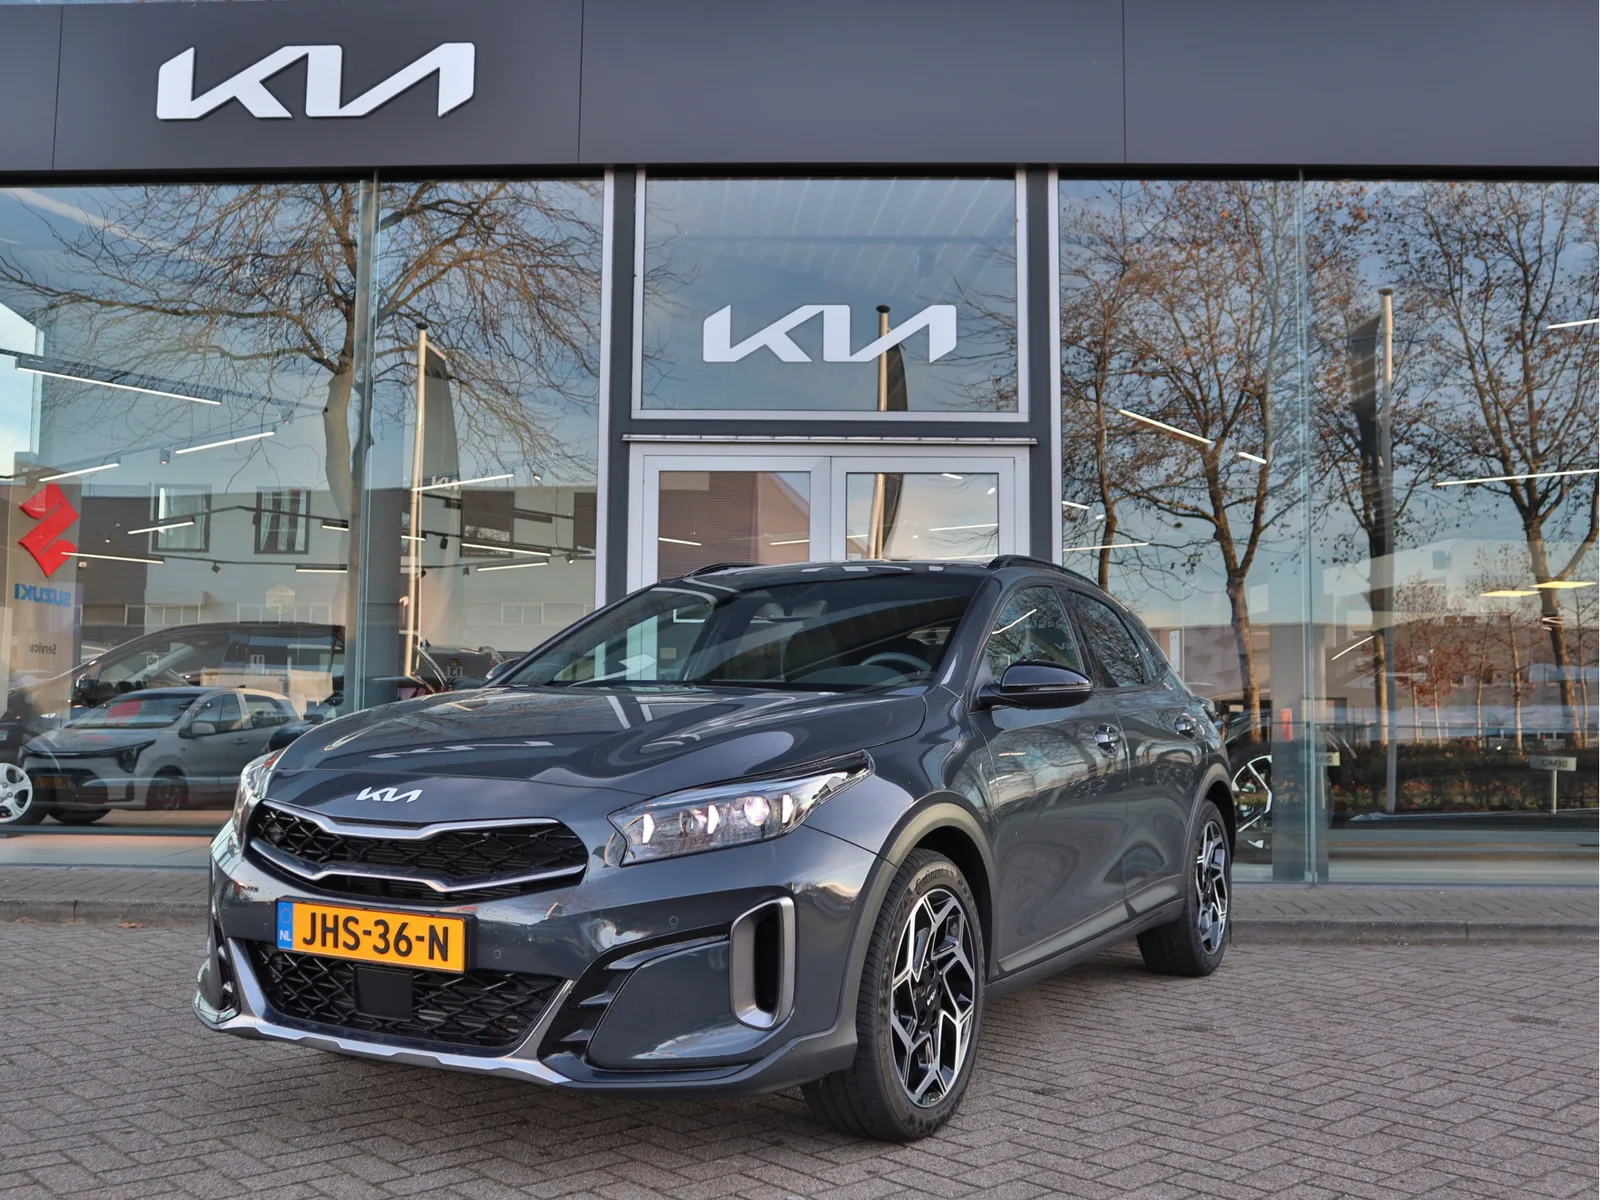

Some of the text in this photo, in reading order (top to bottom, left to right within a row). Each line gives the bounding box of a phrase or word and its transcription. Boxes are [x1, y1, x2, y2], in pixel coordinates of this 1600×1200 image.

[156, 42, 476, 120] KIA
[703, 304, 957, 363] KIA
[356, 787, 422, 803] KIA
[279, 930, 292, 942] NL
[302, 912, 450, 962] JHS-36-N
